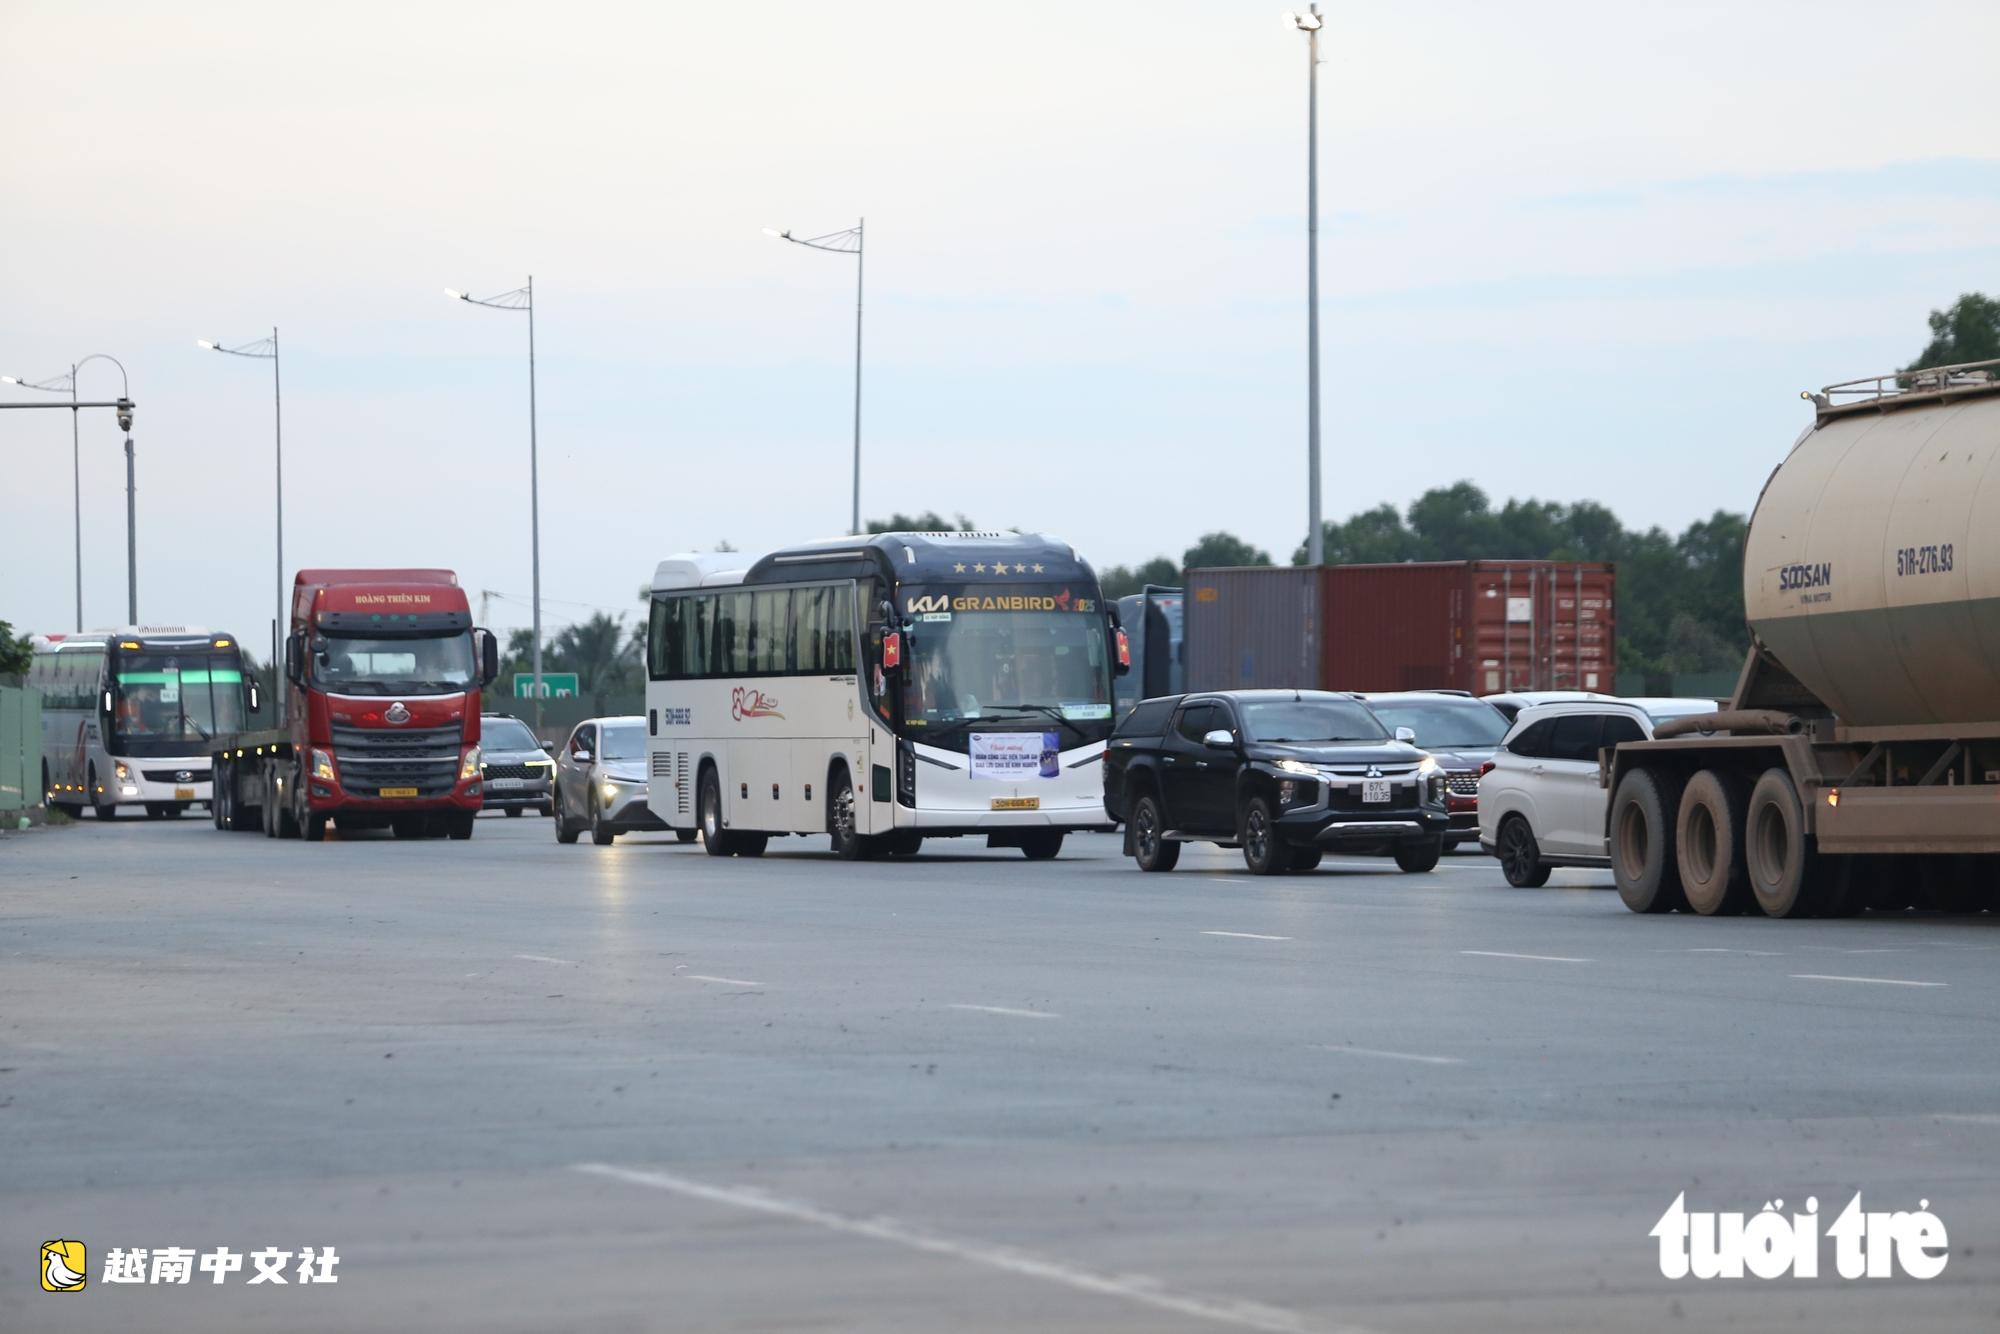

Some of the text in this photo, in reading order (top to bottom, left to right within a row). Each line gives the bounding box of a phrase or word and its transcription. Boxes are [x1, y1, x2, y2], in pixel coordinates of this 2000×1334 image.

[1897, 543, 1953, 576] 51R-276.93
[1779, 562, 1831, 591] SOOSAN
[414, 594, 431, 603] KIM
[907, 594, 949, 613] KIA
[952, 596, 1056, 610] GRANBIRD
[1369, 781, 1385, 791] 67C
